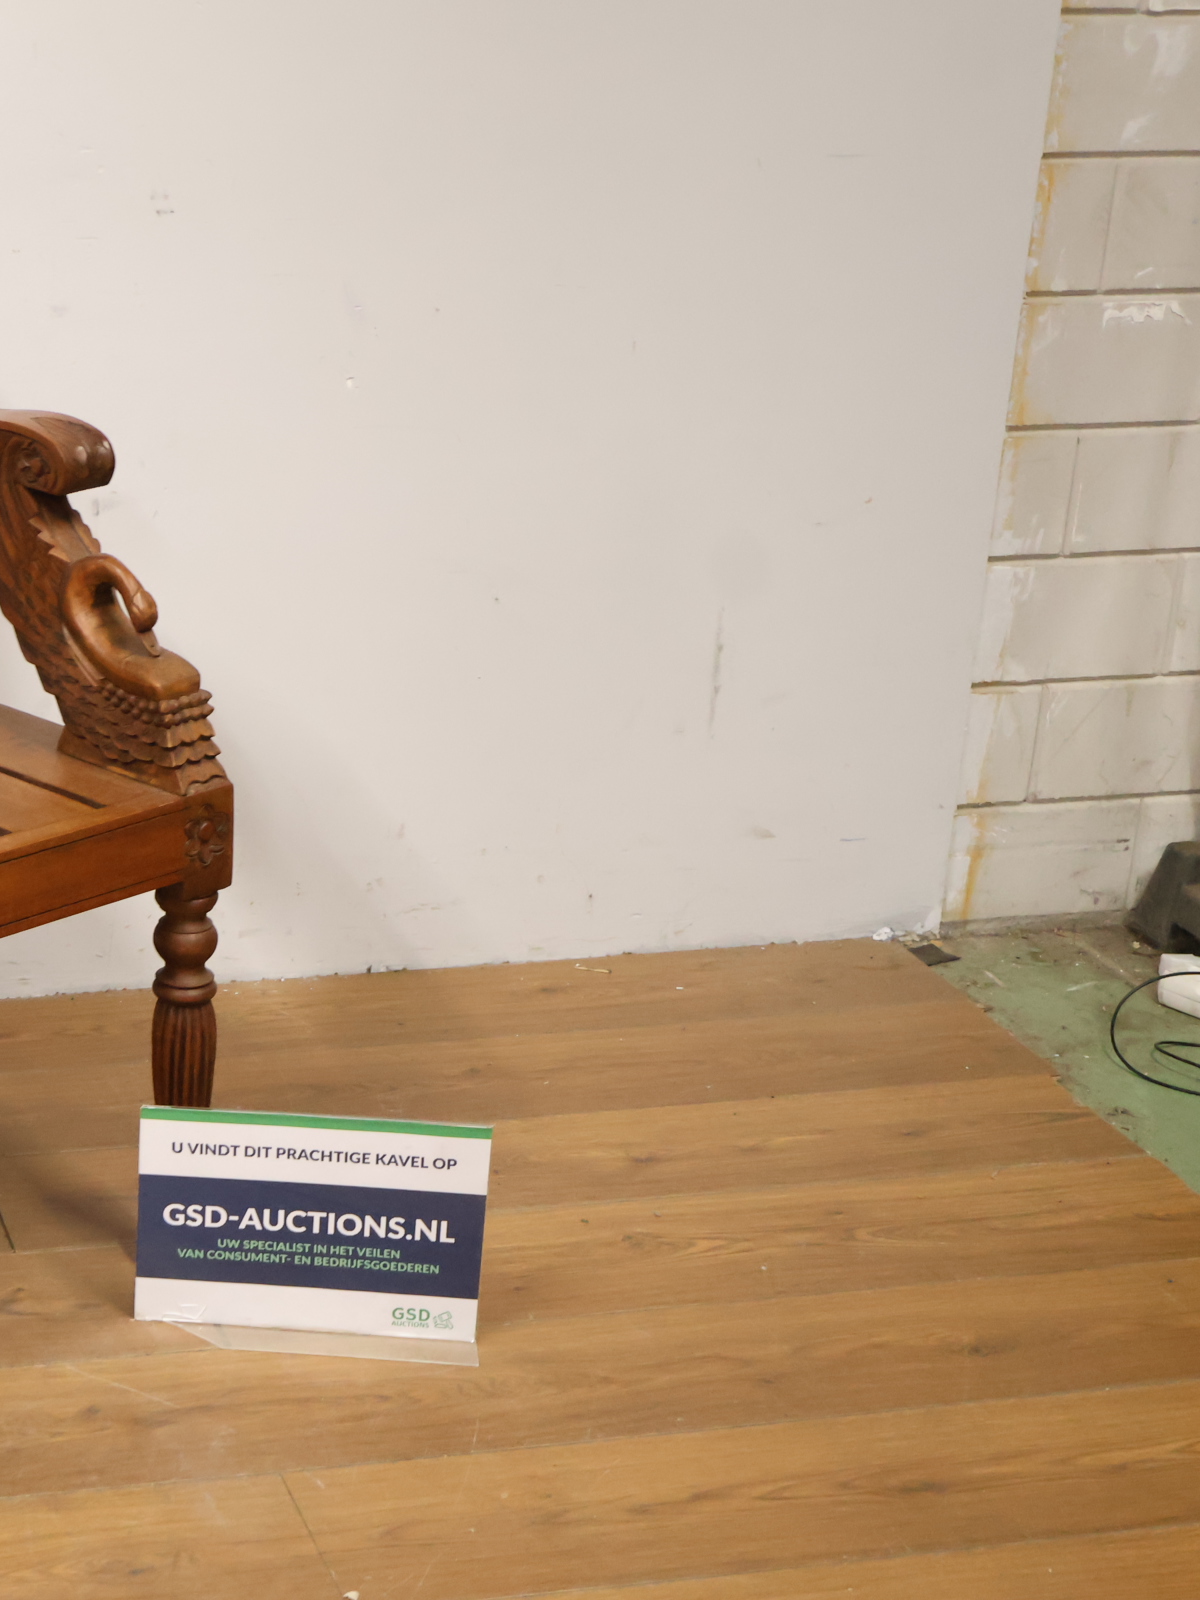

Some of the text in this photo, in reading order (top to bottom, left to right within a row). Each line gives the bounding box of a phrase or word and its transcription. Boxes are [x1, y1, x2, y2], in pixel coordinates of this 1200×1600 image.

[172, 1142, 458, 1170] U VINDT DIT PRACHTIGE KAVEL OP
[162, 1203, 455, 1243] GSD-AUCTIONS.NL
[218, 1238, 401, 1259] UW SPECIALIST IN HET VEILEN
[178, 1248, 440, 1274] VAN CONSUMENT- EN BEDRIJFSGOEDEREN
[391, 1320, 429, 1328] AUCTIONS
[392, 1307, 430, 1321] GSD
